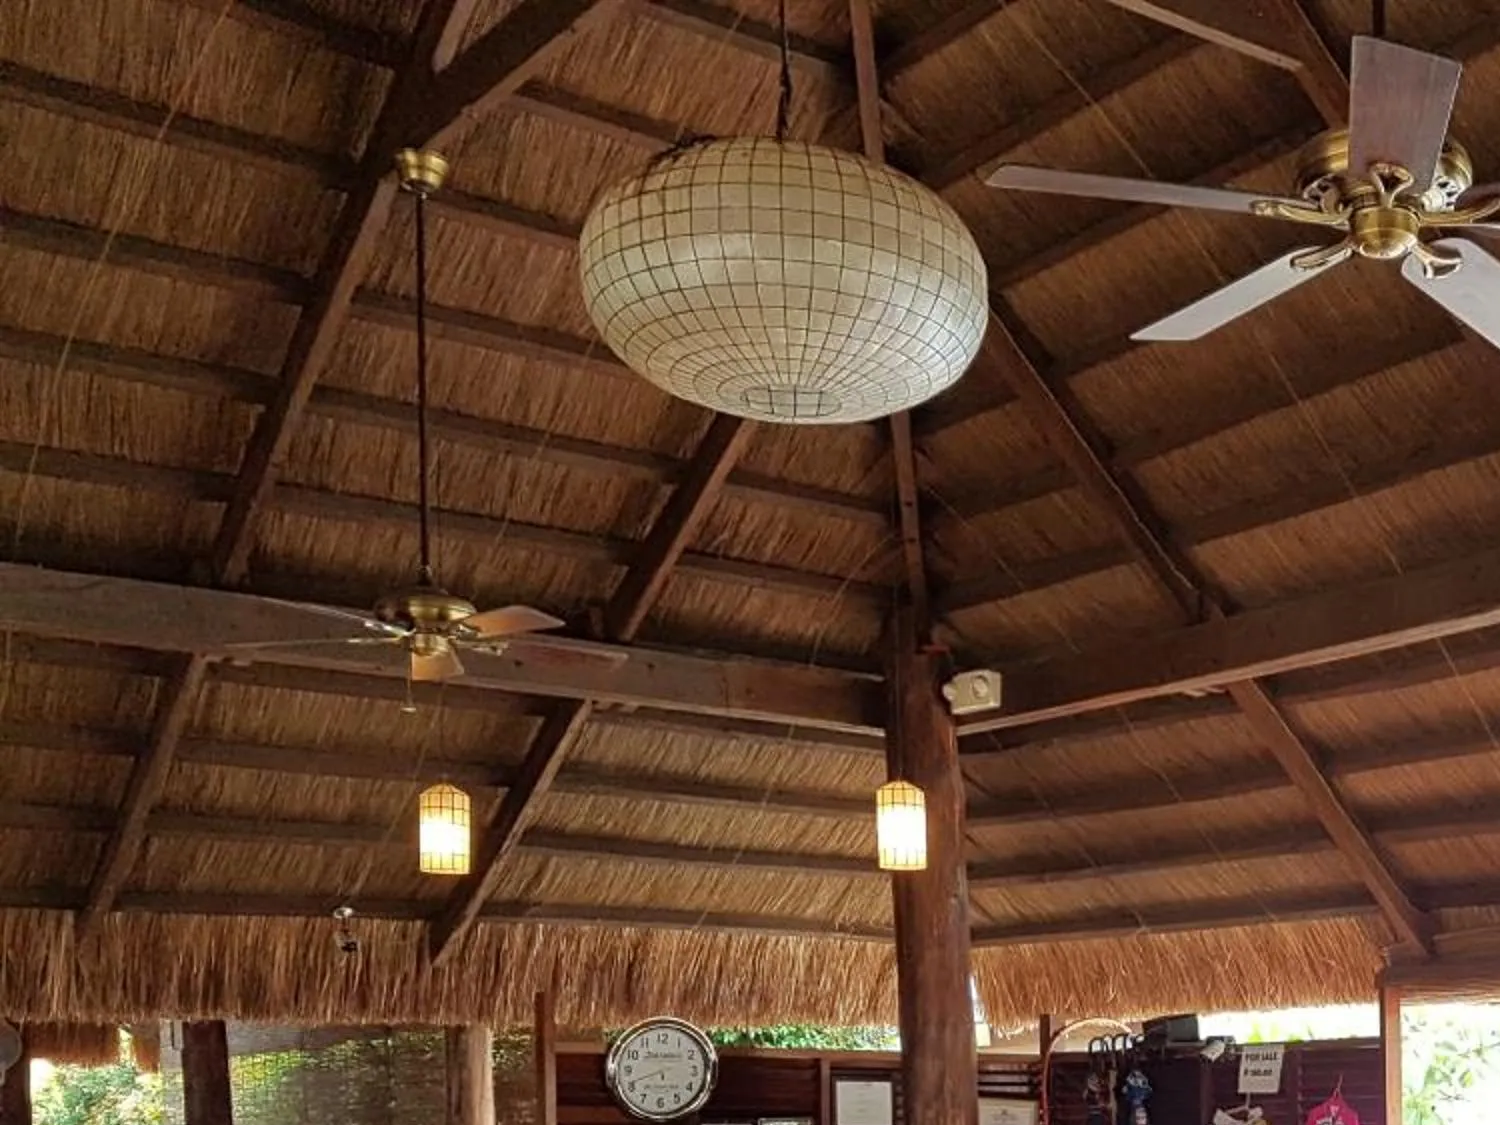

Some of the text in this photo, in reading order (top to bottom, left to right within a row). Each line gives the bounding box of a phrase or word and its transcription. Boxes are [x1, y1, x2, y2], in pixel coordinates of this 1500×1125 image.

[656, 1033, 669, 1045] 12
[627, 1050, 640, 1061] 10
[687, 1050, 695, 1060] 2
[624, 1064, 632, 1075] 9
[690, 1065, 698, 1077] 3
[628, 1080, 636, 1092] 8
[685, 1081, 694, 1092] 4
[639, 1093, 647, 1104] 7
[656, 1097, 665, 1108] 6
[673, 1092, 681, 1105] 5
